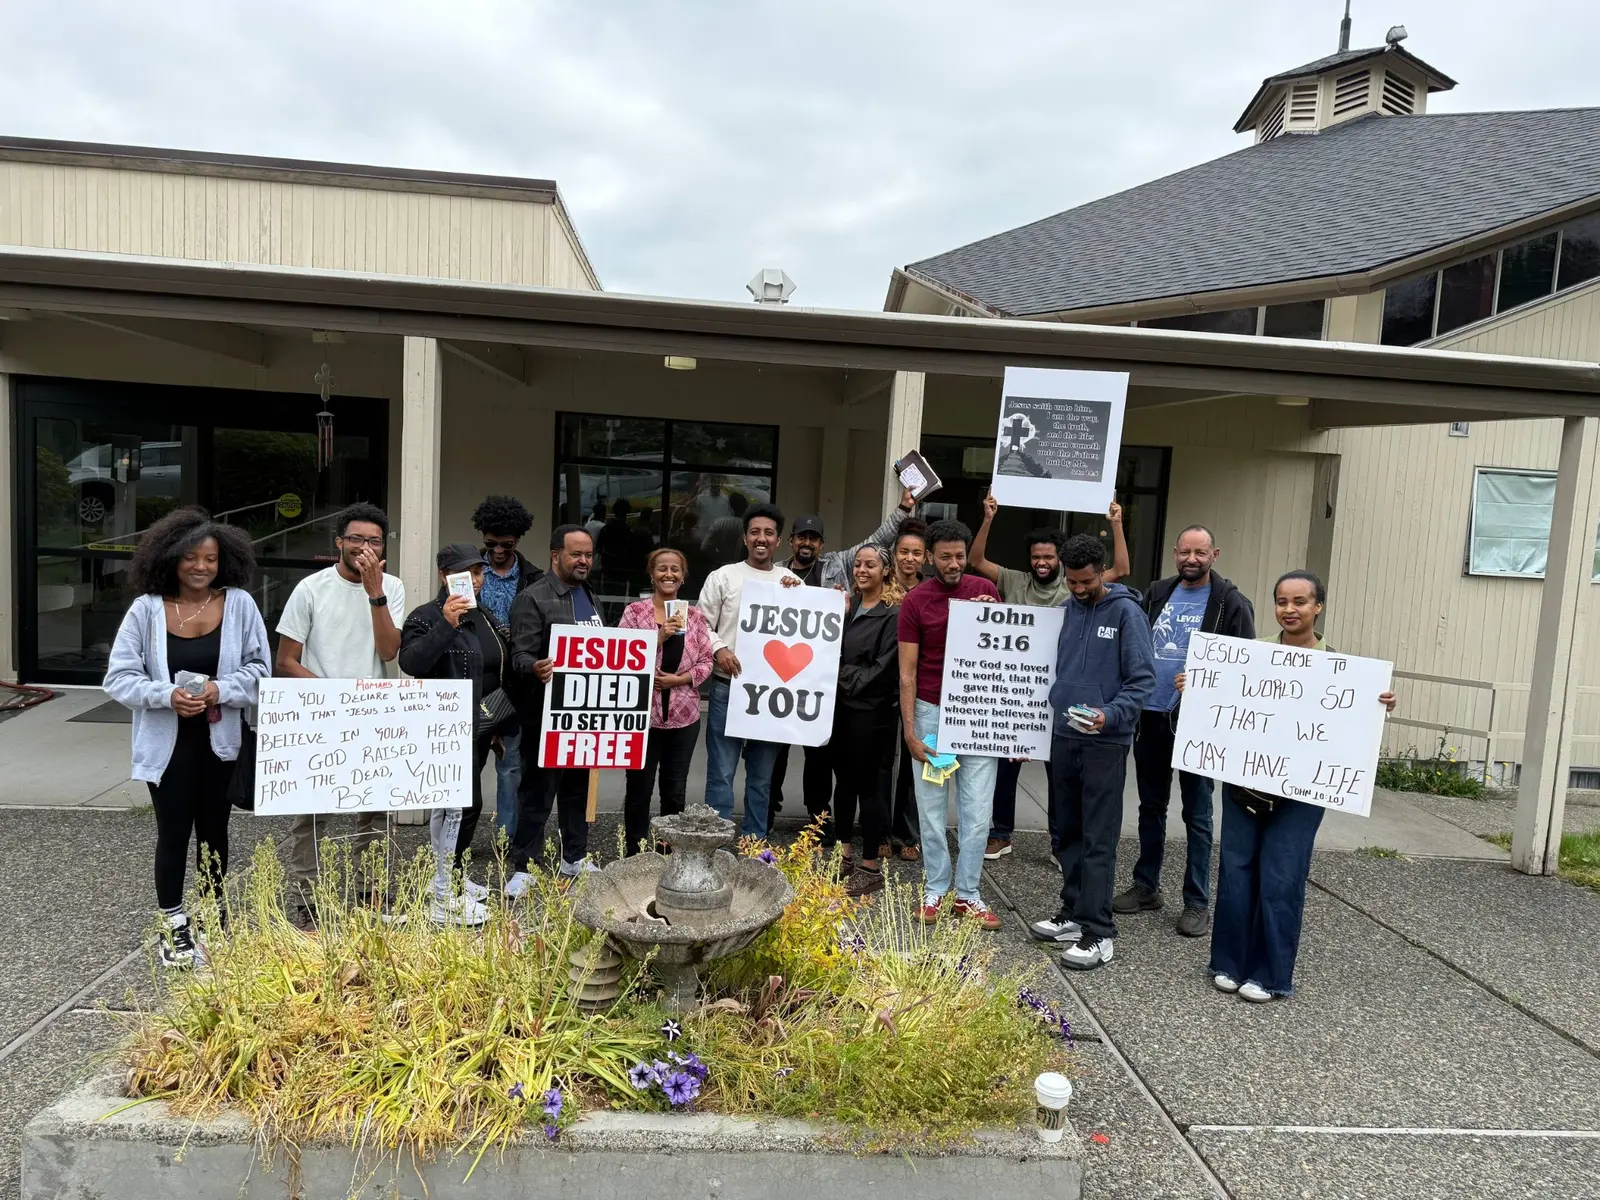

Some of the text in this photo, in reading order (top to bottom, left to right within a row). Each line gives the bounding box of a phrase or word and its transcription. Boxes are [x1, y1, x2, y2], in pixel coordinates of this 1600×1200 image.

[1074, 404, 1092, 412] him,
[1068, 423, 1090, 431] truth,
[1061, 459, 1071, 467] by
[740, 603, 841, 642] JESUS
[976, 607, 1035, 626] John
[977, 632, 1030, 652] 3:16
[1097, 626, 1117, 639] CAT
[552, 636, 647, 671] JESUS
[1193, 634, 1348, 674] JESUS CAME TO
[954, 658, 976, 668] "For
[980, 660, 1001, 670] God
[1021, 663, 1049, 673] loved
[397, 679, 423, 689] 10:9
[952, 670, 1049, 685] the world, that He
[298, 692, 325, 706] YOU
[399, 691, 428, 701] WITH
[436, 690, 460, 701] YOUR
[563, 673, 640, 708] DIED
[963, 684, 1035, 698] gave His only
[1189, 668, 1355, 710] THE WORLD SO
[742, 683, 824, 722] YOU
[948, 693, 1047, 708] begotten Son, and
[260, 710, 300, 725] MOUTH
[310, 709, 337, 721] THAT
[384, 706, 396, 714] IS
[945, 705, 1048, 720] whoever believes in
[550, 713, 646, 732] TO SET YOU
[945, 716, 1046, 732] Him will not perish
[1209, 704, 1329, 742] THAT WE
[259, 732, 328, 753] BELIEVE
[340, 728, 360, 743] IN
[374, 726, 408, 741] YOUR
[972, 730, 1018, 741] but have
[258, 740, 461, 775] THAT GOD RAISED HIM
[556, 732, 632, 767] FREE
[951, 742, 1036, 754] everlasting life"
[1182, 740, 1365, 795] MAY HAVE LIFE
[258, 780, 298, 807] FROM
[305, 773, 336, 789] THE
[350, 765, 393, 785] DEAD,
[1282, 779, 1344, 806] (JOHN 10:10)
[331, 785, 374, 809] BE
